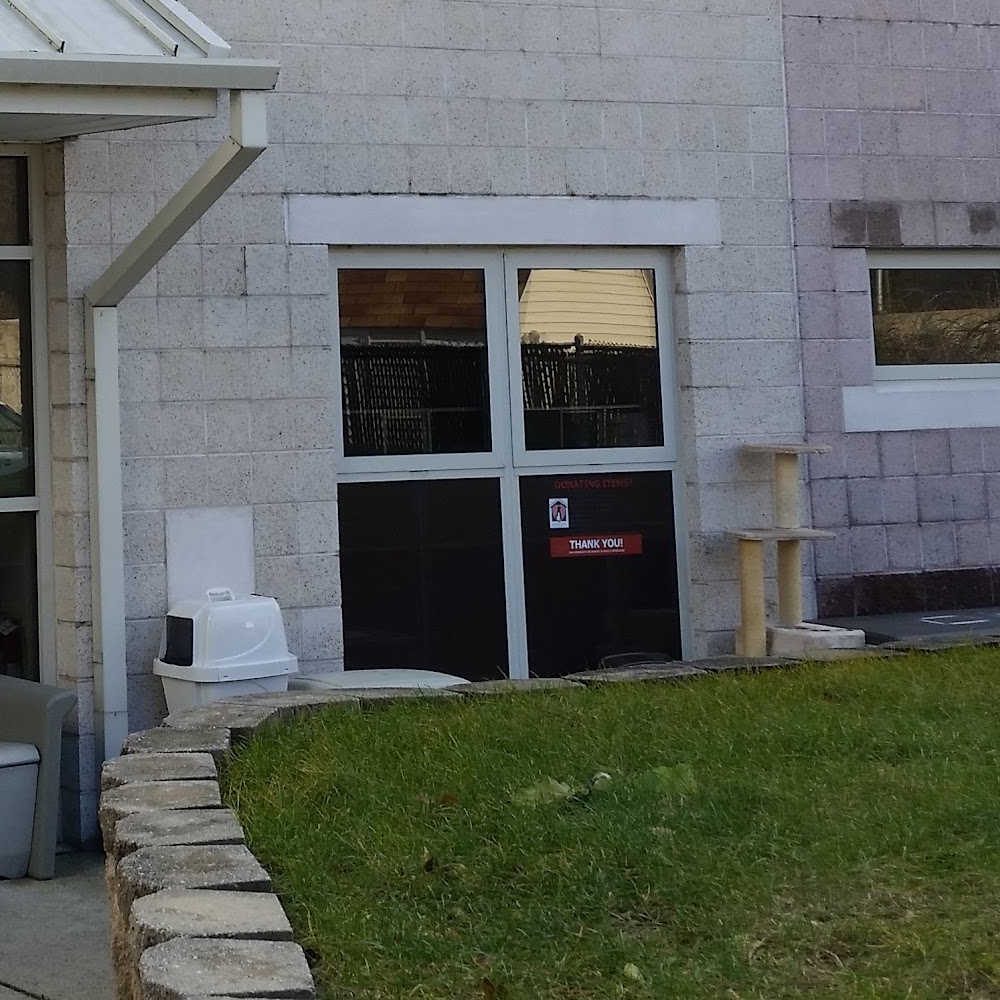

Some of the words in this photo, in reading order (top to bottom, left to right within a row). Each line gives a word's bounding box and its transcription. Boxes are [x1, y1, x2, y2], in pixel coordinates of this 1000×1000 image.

[554, 479, 600, 489] DONATING
[569, 539, 600, 549] THANK
[601, 538, 624, 548] YOU!
